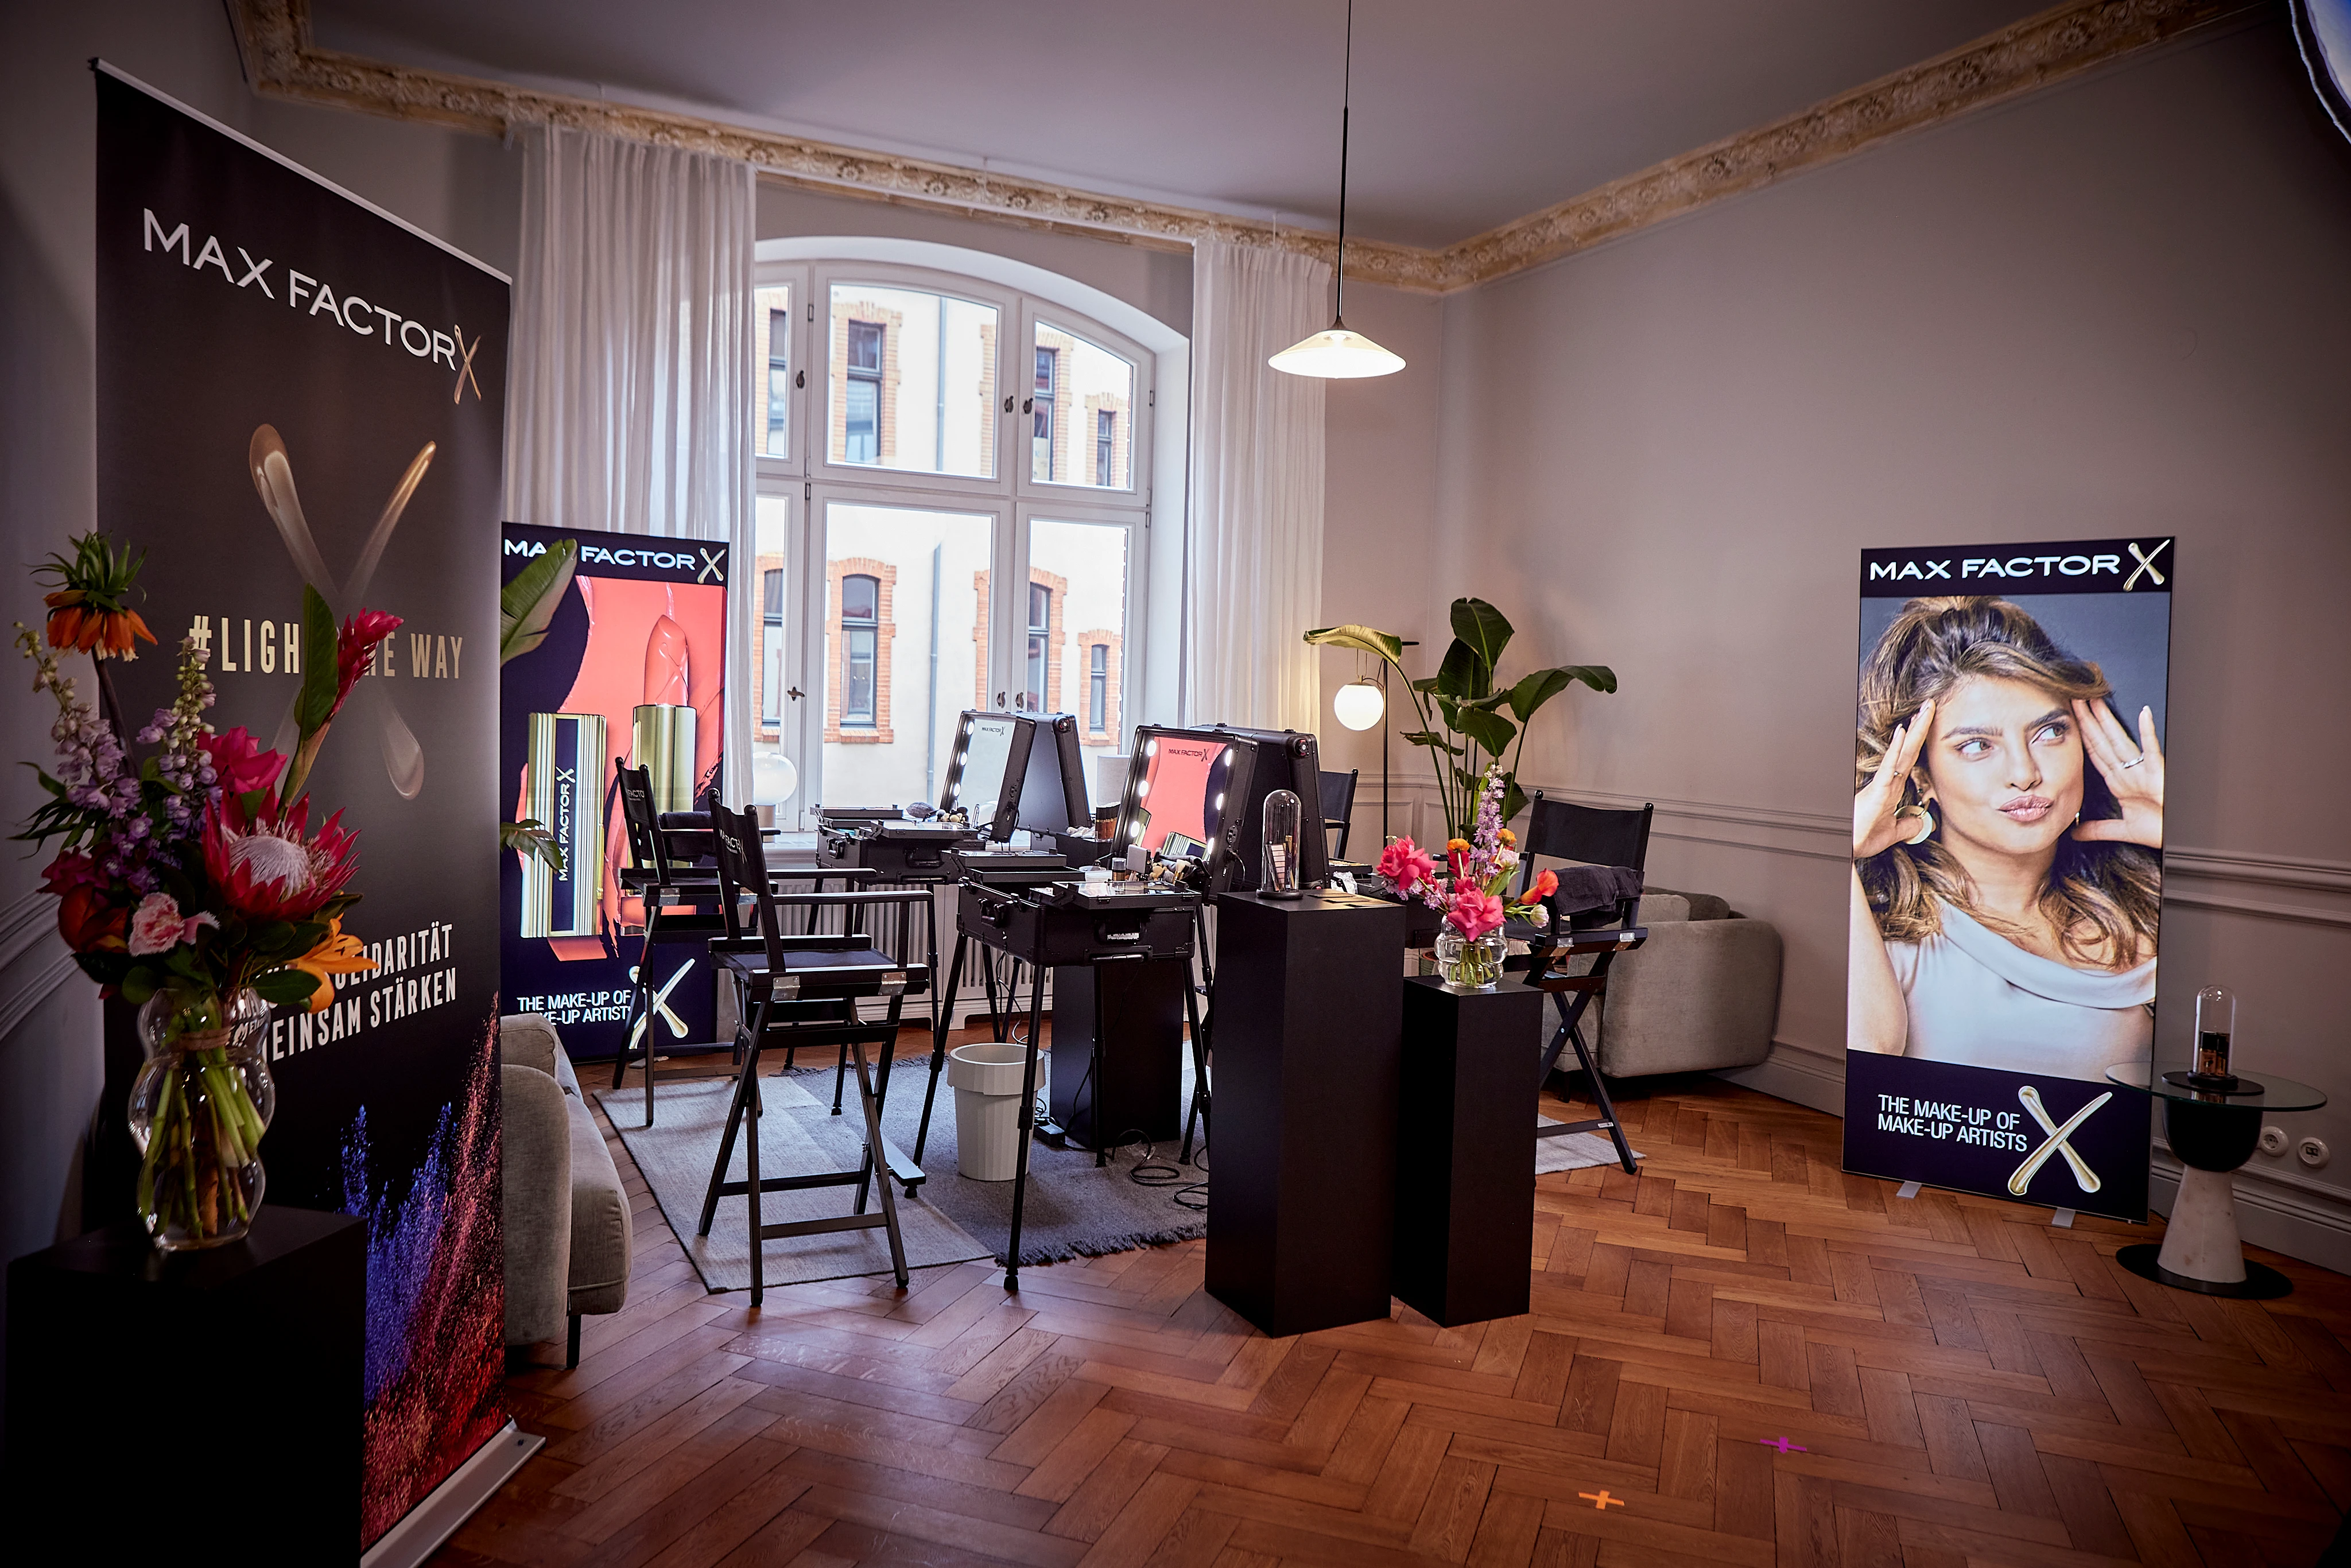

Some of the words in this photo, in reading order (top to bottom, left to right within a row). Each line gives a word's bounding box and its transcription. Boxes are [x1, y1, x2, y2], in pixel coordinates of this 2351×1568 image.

[144, 208, 275, 300] MAX
[289, 269, 456, 371] FACTOR
[505, 538, 547, 558] MA
[581, 546, 696, 570] FACTOR
[1869, 560, 1952, 581] MAX
[1962, 554, 2121, 579] FACTOR
[189, 615, 300, 674] #LIGH
[410, 632, 463, 680] WAY
[627, 789, 645, 798] FACTO
[559, 783, 571, 845] FACTOR
[324, 921, 453, 991] IDARITÄT
[262, 996, 361, 1065] EINSAM
[370, 967, 456, 1028] STÄRKEN
[517, 995, 544, 1012] THE
[548, 991, 610, 1010] MAKE-UP
[613, 989, 631, 1004] OF
[539, 1010, 580, 1026] E-UP
[582, 1006, 631, 1023] ARTIST
[1877, 1093, 1910, 1116] THE
[1914, 1099, 1992, 1126] MAKE-UP
[1996, 1111, 2020, 1130] OF
[1877, 1113, 1954, 1140] MAKE-UP
[1956, 1126, 2027, 1152] ARTISTS
